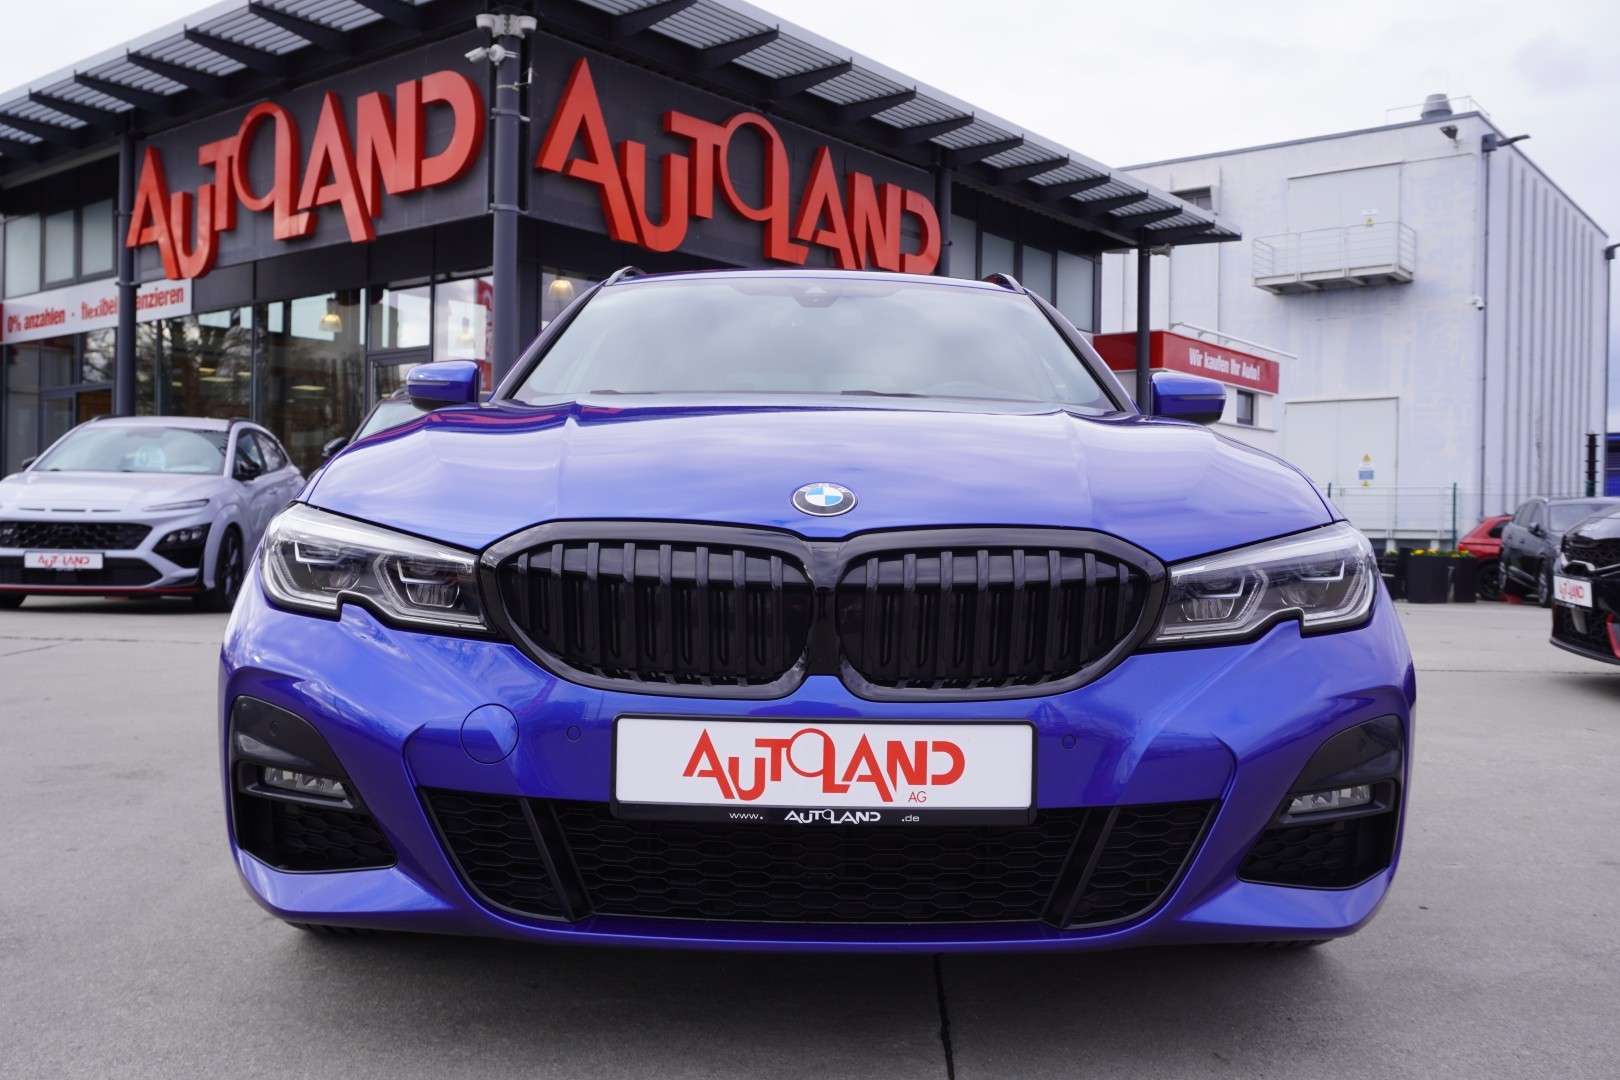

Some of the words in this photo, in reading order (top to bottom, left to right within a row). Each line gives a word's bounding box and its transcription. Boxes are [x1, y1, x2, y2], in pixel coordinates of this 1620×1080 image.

[126, 70, 485, 280] AUTOLAND
[536, 57, 942, 275] AUTOLAND
[8, 315, 22, 333] 0%
[24, 307, 65, 330] anzahlen
[136, 287, 184, 311] anzieren
[1188, 347, 1203, 367] Wir
[682, 728, 966, 802] AUTOLAND
[728, 811, 764, 820] www.
[783, 808, 882, 825] AUTOLAND
[901, 814, 920, 823] .de
[908, 791, 928, 803] AG
